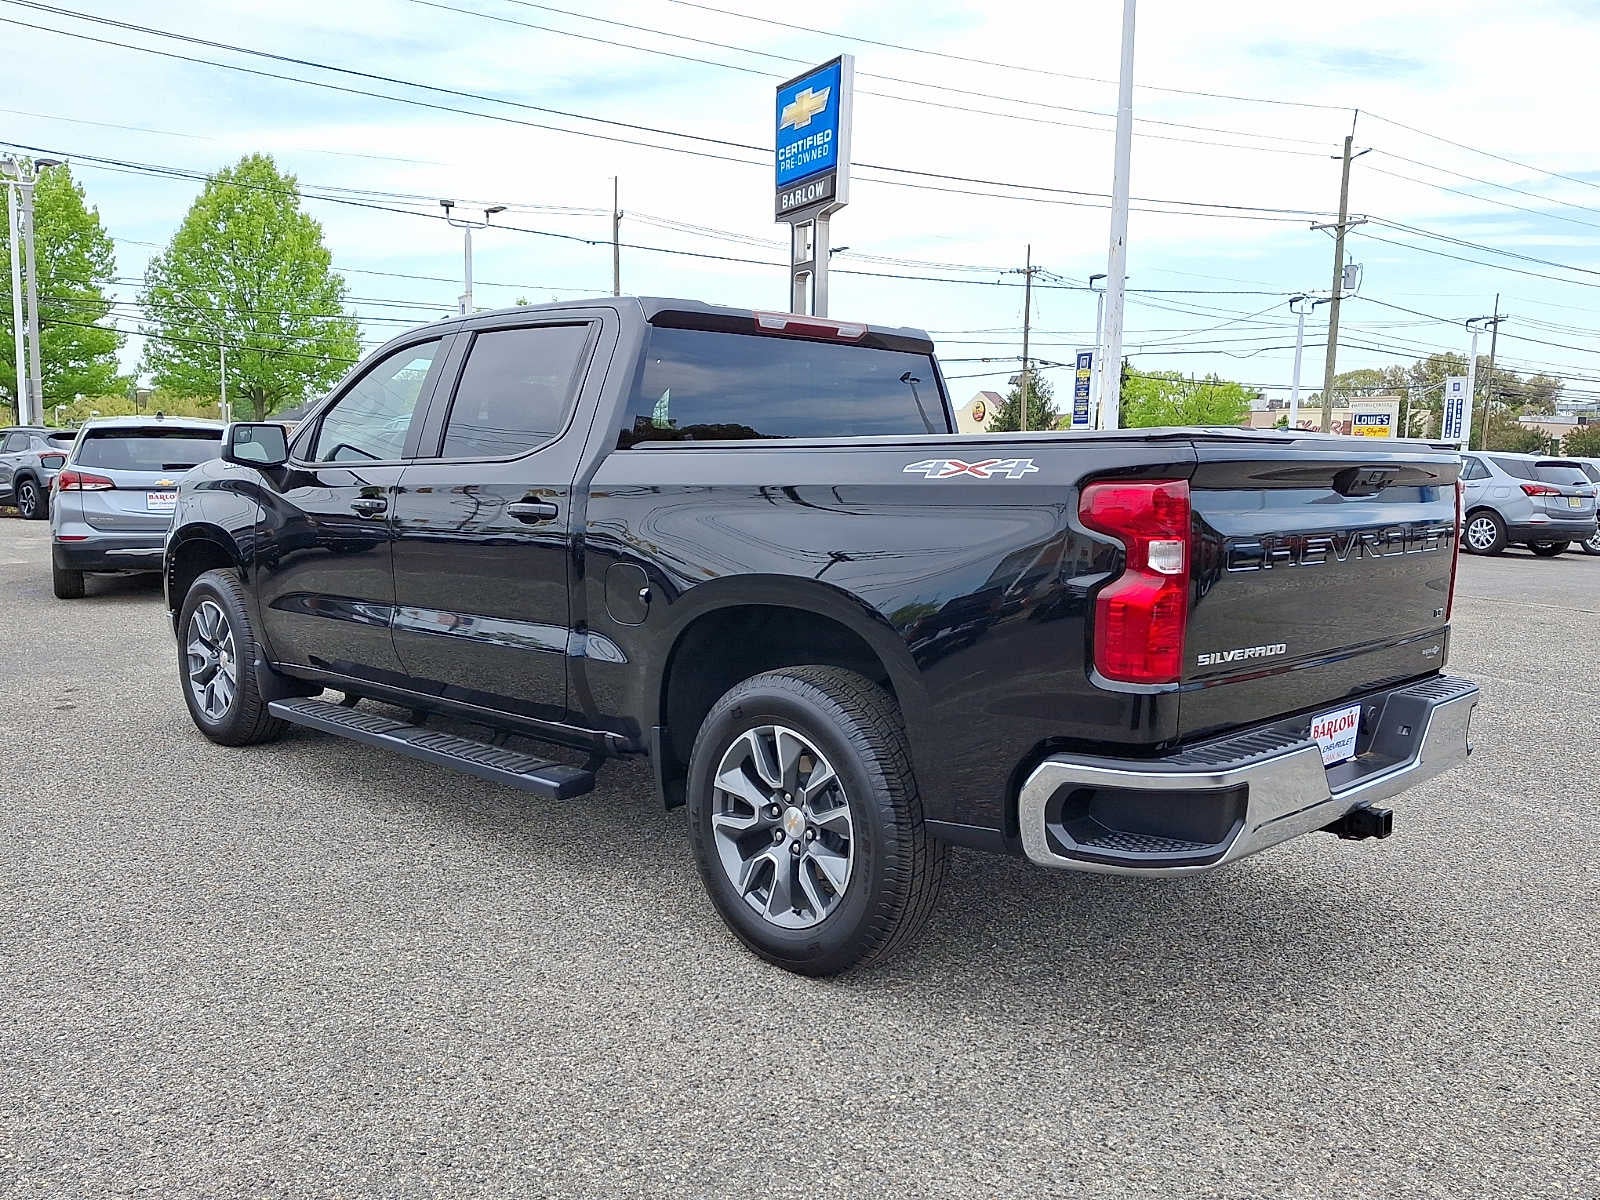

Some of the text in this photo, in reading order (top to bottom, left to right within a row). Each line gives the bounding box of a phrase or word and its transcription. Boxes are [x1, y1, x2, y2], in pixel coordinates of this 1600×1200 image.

[779, 129, 832, 161] CERTIFIED
[780, 144, 829, 173] PRE-OWNED
[782, 181, 825, 209] BARLOW
[1355, 414, 1390, 425] LOWE'S
[1225, 526, 1454, 573] CHEVROLET
[1197, 643, 1287, 666] SILVERADO
[1313, 713, 1358, 740] BARLOW
[1322, 737, 1355, 753] CHEVROLET
